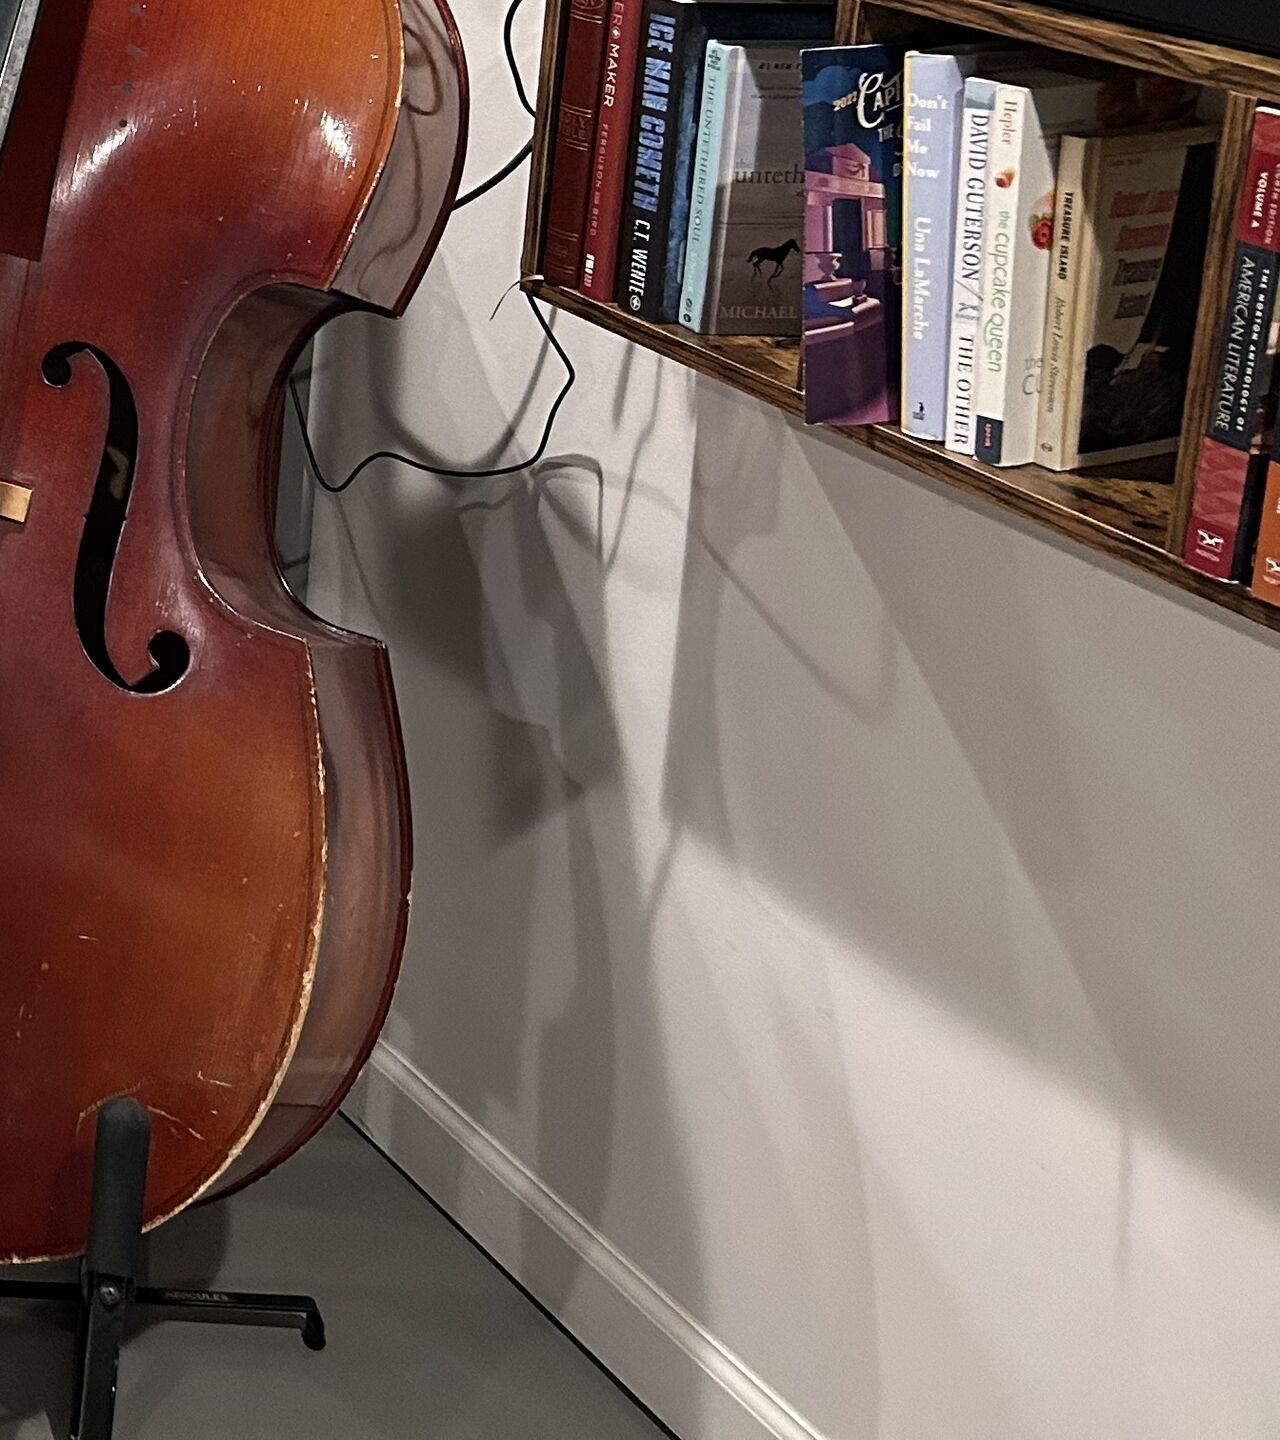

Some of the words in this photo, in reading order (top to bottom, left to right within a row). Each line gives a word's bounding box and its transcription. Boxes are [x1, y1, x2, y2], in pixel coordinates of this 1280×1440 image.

[646, 12, 677, 54] ICE
[603, 43, 621, 107] MAKER
[641, 57, 672, 112] MAN
[907, 93, 949, 110] Don't
[998, 100, 1017, 145] Hepler
[592, 123, 609, 189] FERGUSON
[632, 114, 666, 213] COMETH
[696, 106, 714, 206] UNTETHERED
[907, 138, 929, 155] Me
[968, 113, 989, 170] DAVID
[906, 160, 940, 179] Now
[1058, 191, 1074, 242] TREASURE
[1252, 172, 1269, 217] VOLUME
[590, 207, 600, 236] BIRD
[633, 218, 651, 242] C.T.
[691, 209, 703, 243] SOUL
[914, 216, 931, 252] Una
[962, 177, 986, 281] GUTERSON
[998, 210, 1011, 229] the
[1250, 219, 1261, 229] A
[629, 248, 649, 297] WENTE
[988, 231, 1011, 309] cupcake
[1056, 244, 1070, 280] ISLAND
[1259, 268, 1271, 289] THE
[720, 305, 798, 320] MICHAEL
[911, 259, 931, 341] LaMarche
[1053, 297, 1068, 332] Robert
[1229, 256, 1256, 343] AMERICAN
[1251, 294, 1265, 340] NORTON
[957, 333, 975, 372] THE
[1215, 346, 1241, 432] LITERATURE
[1239, 345, 1256, 415] ANTHOLOGY
[954, 378, 972, 445] OTHER
